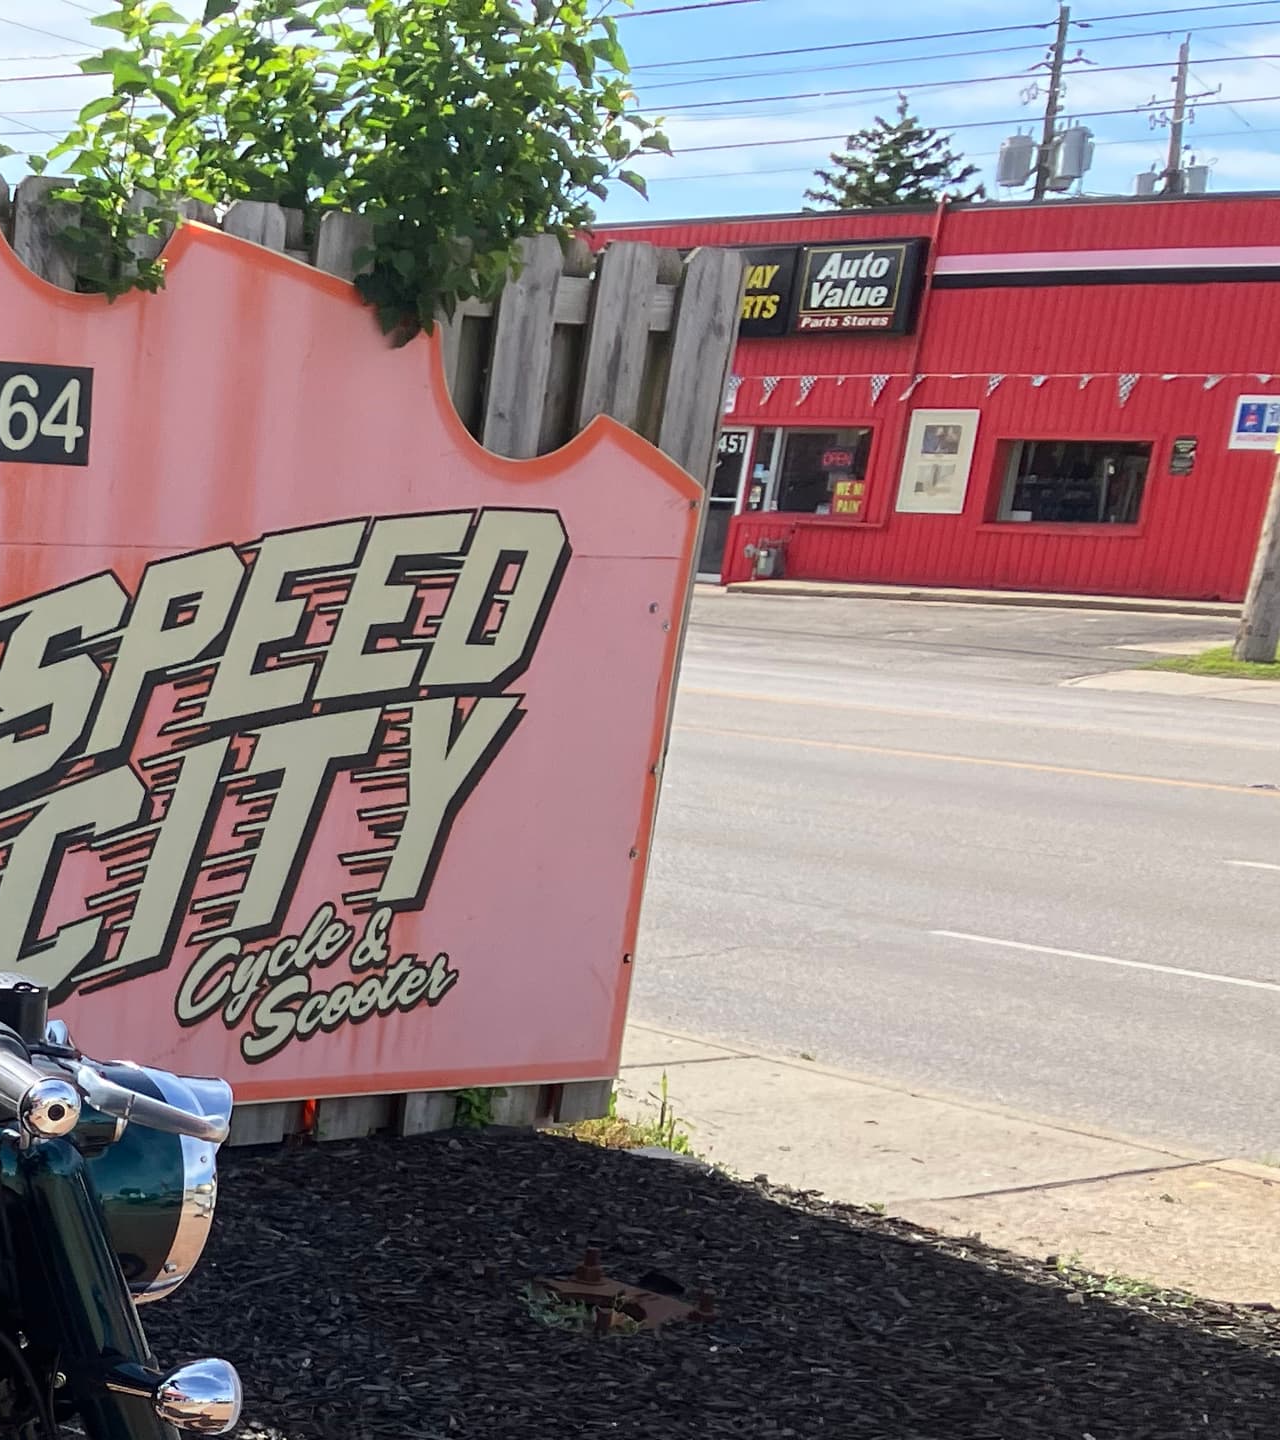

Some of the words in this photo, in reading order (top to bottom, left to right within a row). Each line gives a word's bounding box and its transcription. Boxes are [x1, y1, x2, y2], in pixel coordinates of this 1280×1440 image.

[817, 251, 890, 280] Auto
[810, 280, 888, 308] Value
[801, 316, 839, 328] Parts
[842, 315, 889, 327] Stores
[175, 902, 353, 1030] Cycle
[350, 905, 393, 969] &
[241, 953, 458, 1063] Scooter
